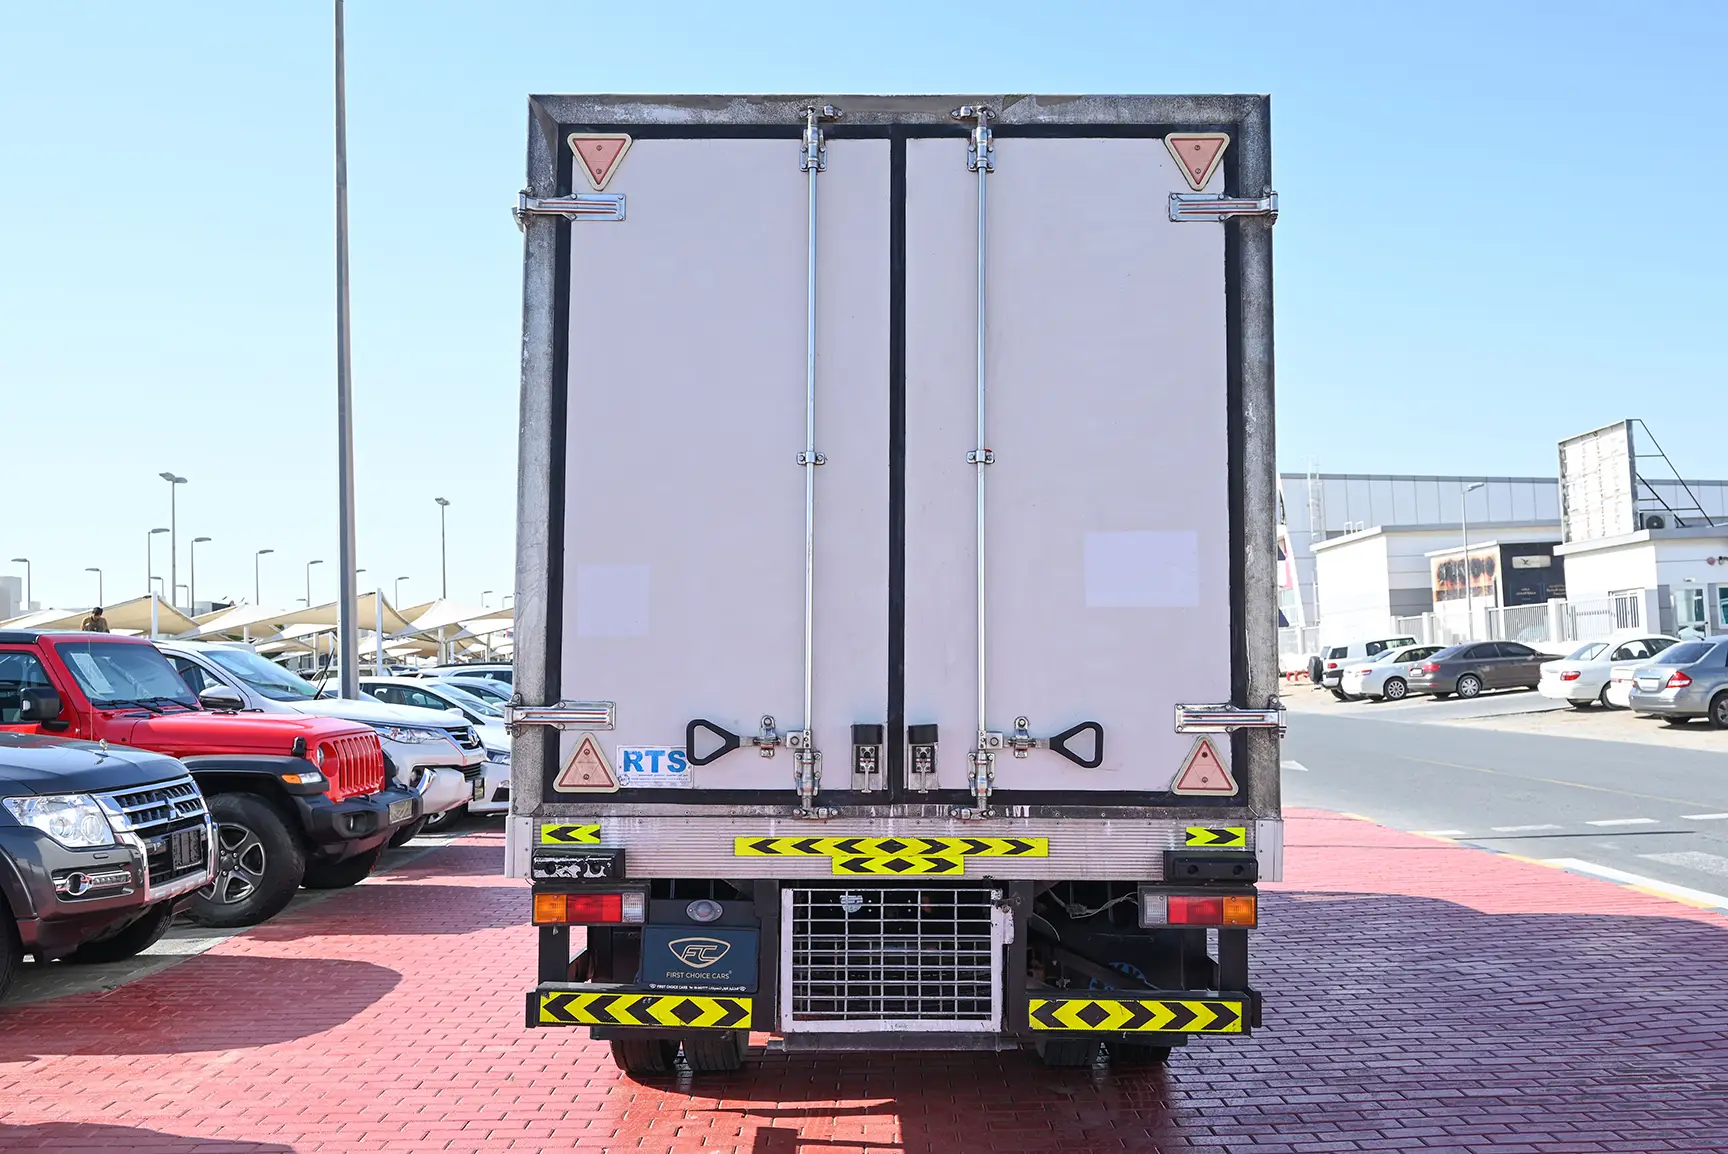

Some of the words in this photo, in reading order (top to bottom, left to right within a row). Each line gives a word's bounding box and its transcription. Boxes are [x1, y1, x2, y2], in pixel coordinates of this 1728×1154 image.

[623, 750, 687, 773] RTS
[666, 971, 684, 979] FIRST
[685, 972, 711, 980] CHOICE
